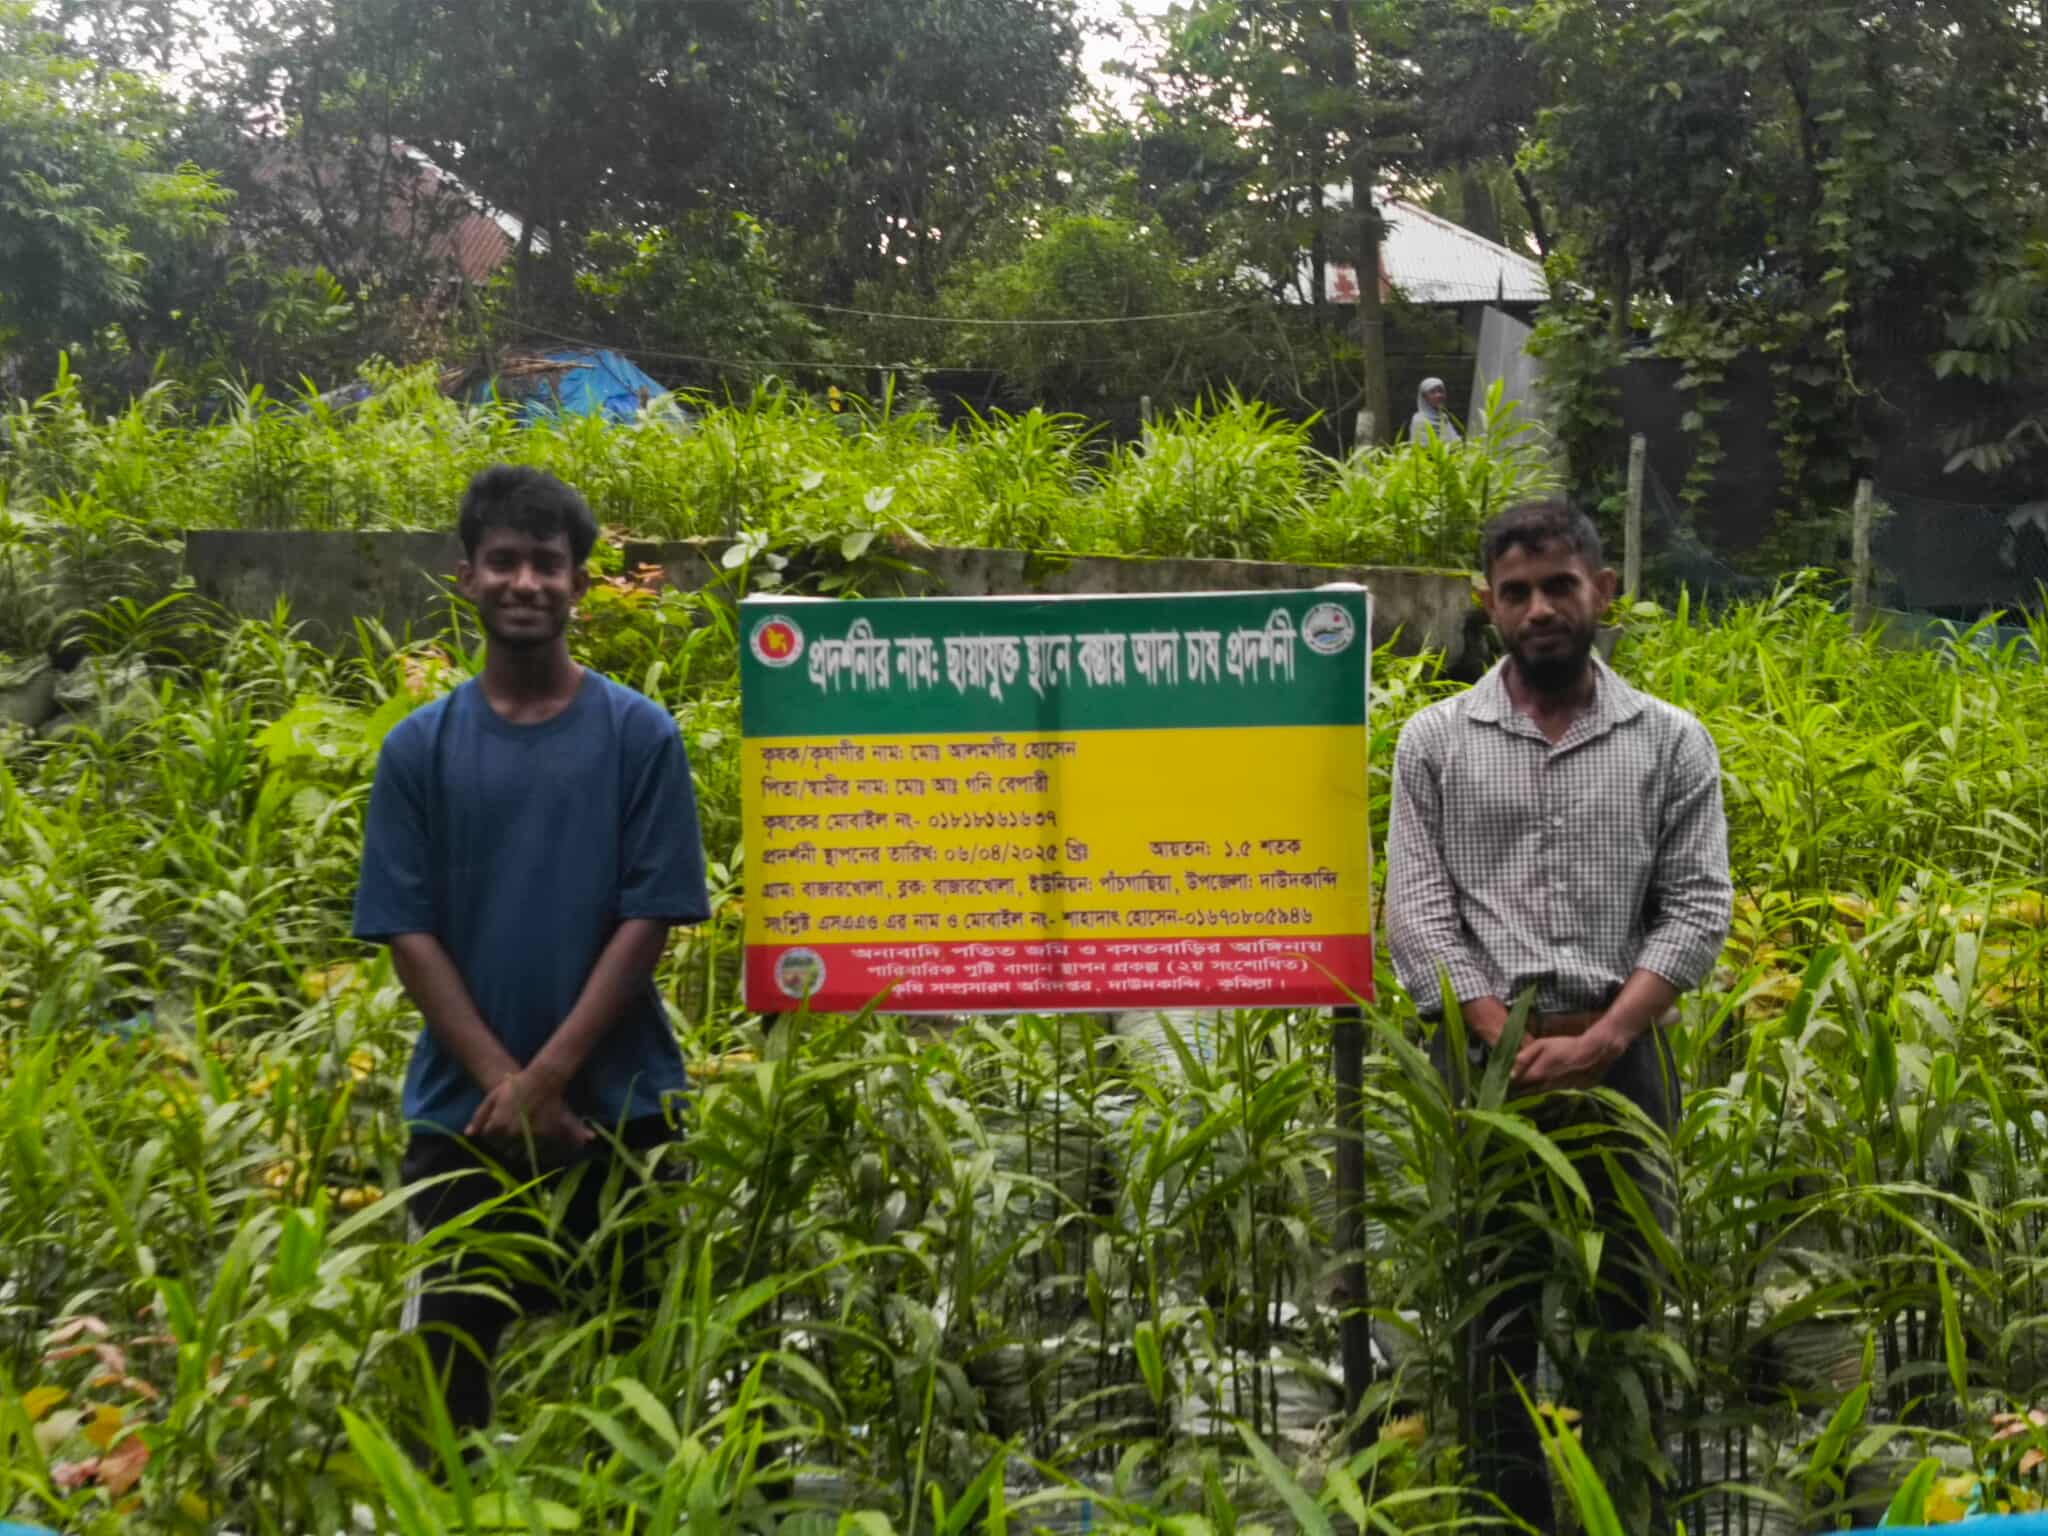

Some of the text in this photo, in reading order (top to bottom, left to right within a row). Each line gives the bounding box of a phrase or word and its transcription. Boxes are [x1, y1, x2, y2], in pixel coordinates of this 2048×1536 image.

[808, 617, 891, 695] প্রদর্শনীর
[943, 633, 1021, 703] ছায়াযুক্ত
[1023, 632, 1073, 699] স্থানে
[1075, 630, 1127, 688] বস্তায়
[1130, 629, 1180, 688] আদা
[1184, 627, 1222, 686] চাষ
[1225, 608, 1297, 686] প্রদর্শনী
[947, 736, 1017, 761] আলমগীর
[1024, 741, 1077, 760] হোসেন
[761, 814, 820, 840] কৃষকের
[827, 809, 888, 831] মোবাইল
[762, 841, 816, 865] প্রদর্শনী
[823, 847, 880, 869] স্থাপনের
[945, 842, 1057, 864] ০৬/০৪/২০২৫
[1224, 840, 1250, 857] ১.৫
[1260, 839, 1302, 855] শতক
[1259, 867, 1338, 890] দাউদকান্দি
[885, 914, 907, 930] এর
[911, 913, 940, 929] নাম
[947, 914, 958, 929] ও
[965, 908, 1023, 929] মোবাইল
[850, 943, 941, 959] অনাবাদি
[951, 943, 1016, 958] পতিত
[1024, 942, 1069, 957] জমি
[1079, 944, 1097, 956] ও
[866, 962, 956, 977] পারিবারিক
[1003, 963, 1052, 975] বাগান
[1061, 962, 1105, 976] স্থাপন
[892, 979, 923, 998] কৃষি
